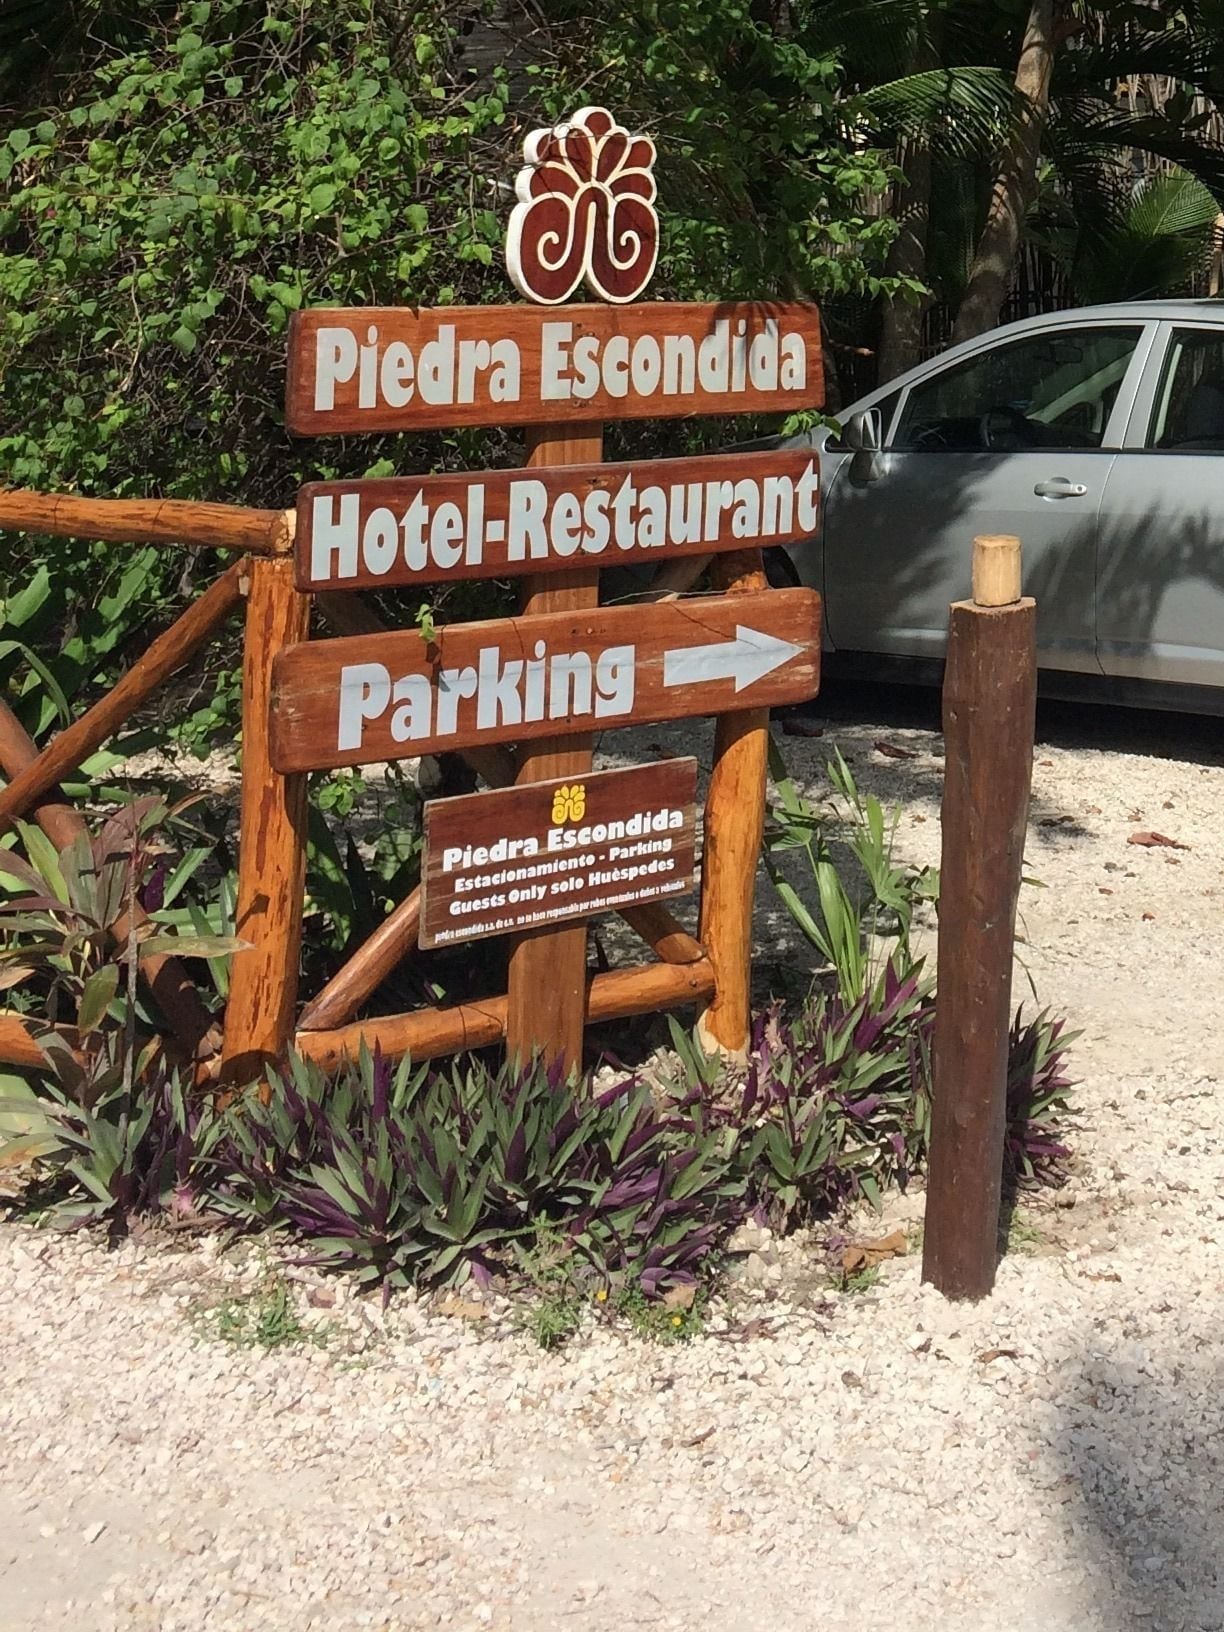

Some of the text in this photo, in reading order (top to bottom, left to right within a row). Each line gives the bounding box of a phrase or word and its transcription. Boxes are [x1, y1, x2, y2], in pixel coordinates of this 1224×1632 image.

[314, 317, 806, 411] Piedra Escondida
[310, 459, 819, 581] Hotel-Restaurant
[338, 640, 636, 751] Parking
[442, 809, 684, 872] Piedra Escondida
[454, 854, 596, 893] Estacionamiento
[609, 838, 672, 862] Parking
[449, 891, 506, 916] Guests
[508, 884, 547, 906] Only
[550, 877, 585, 894] solo
